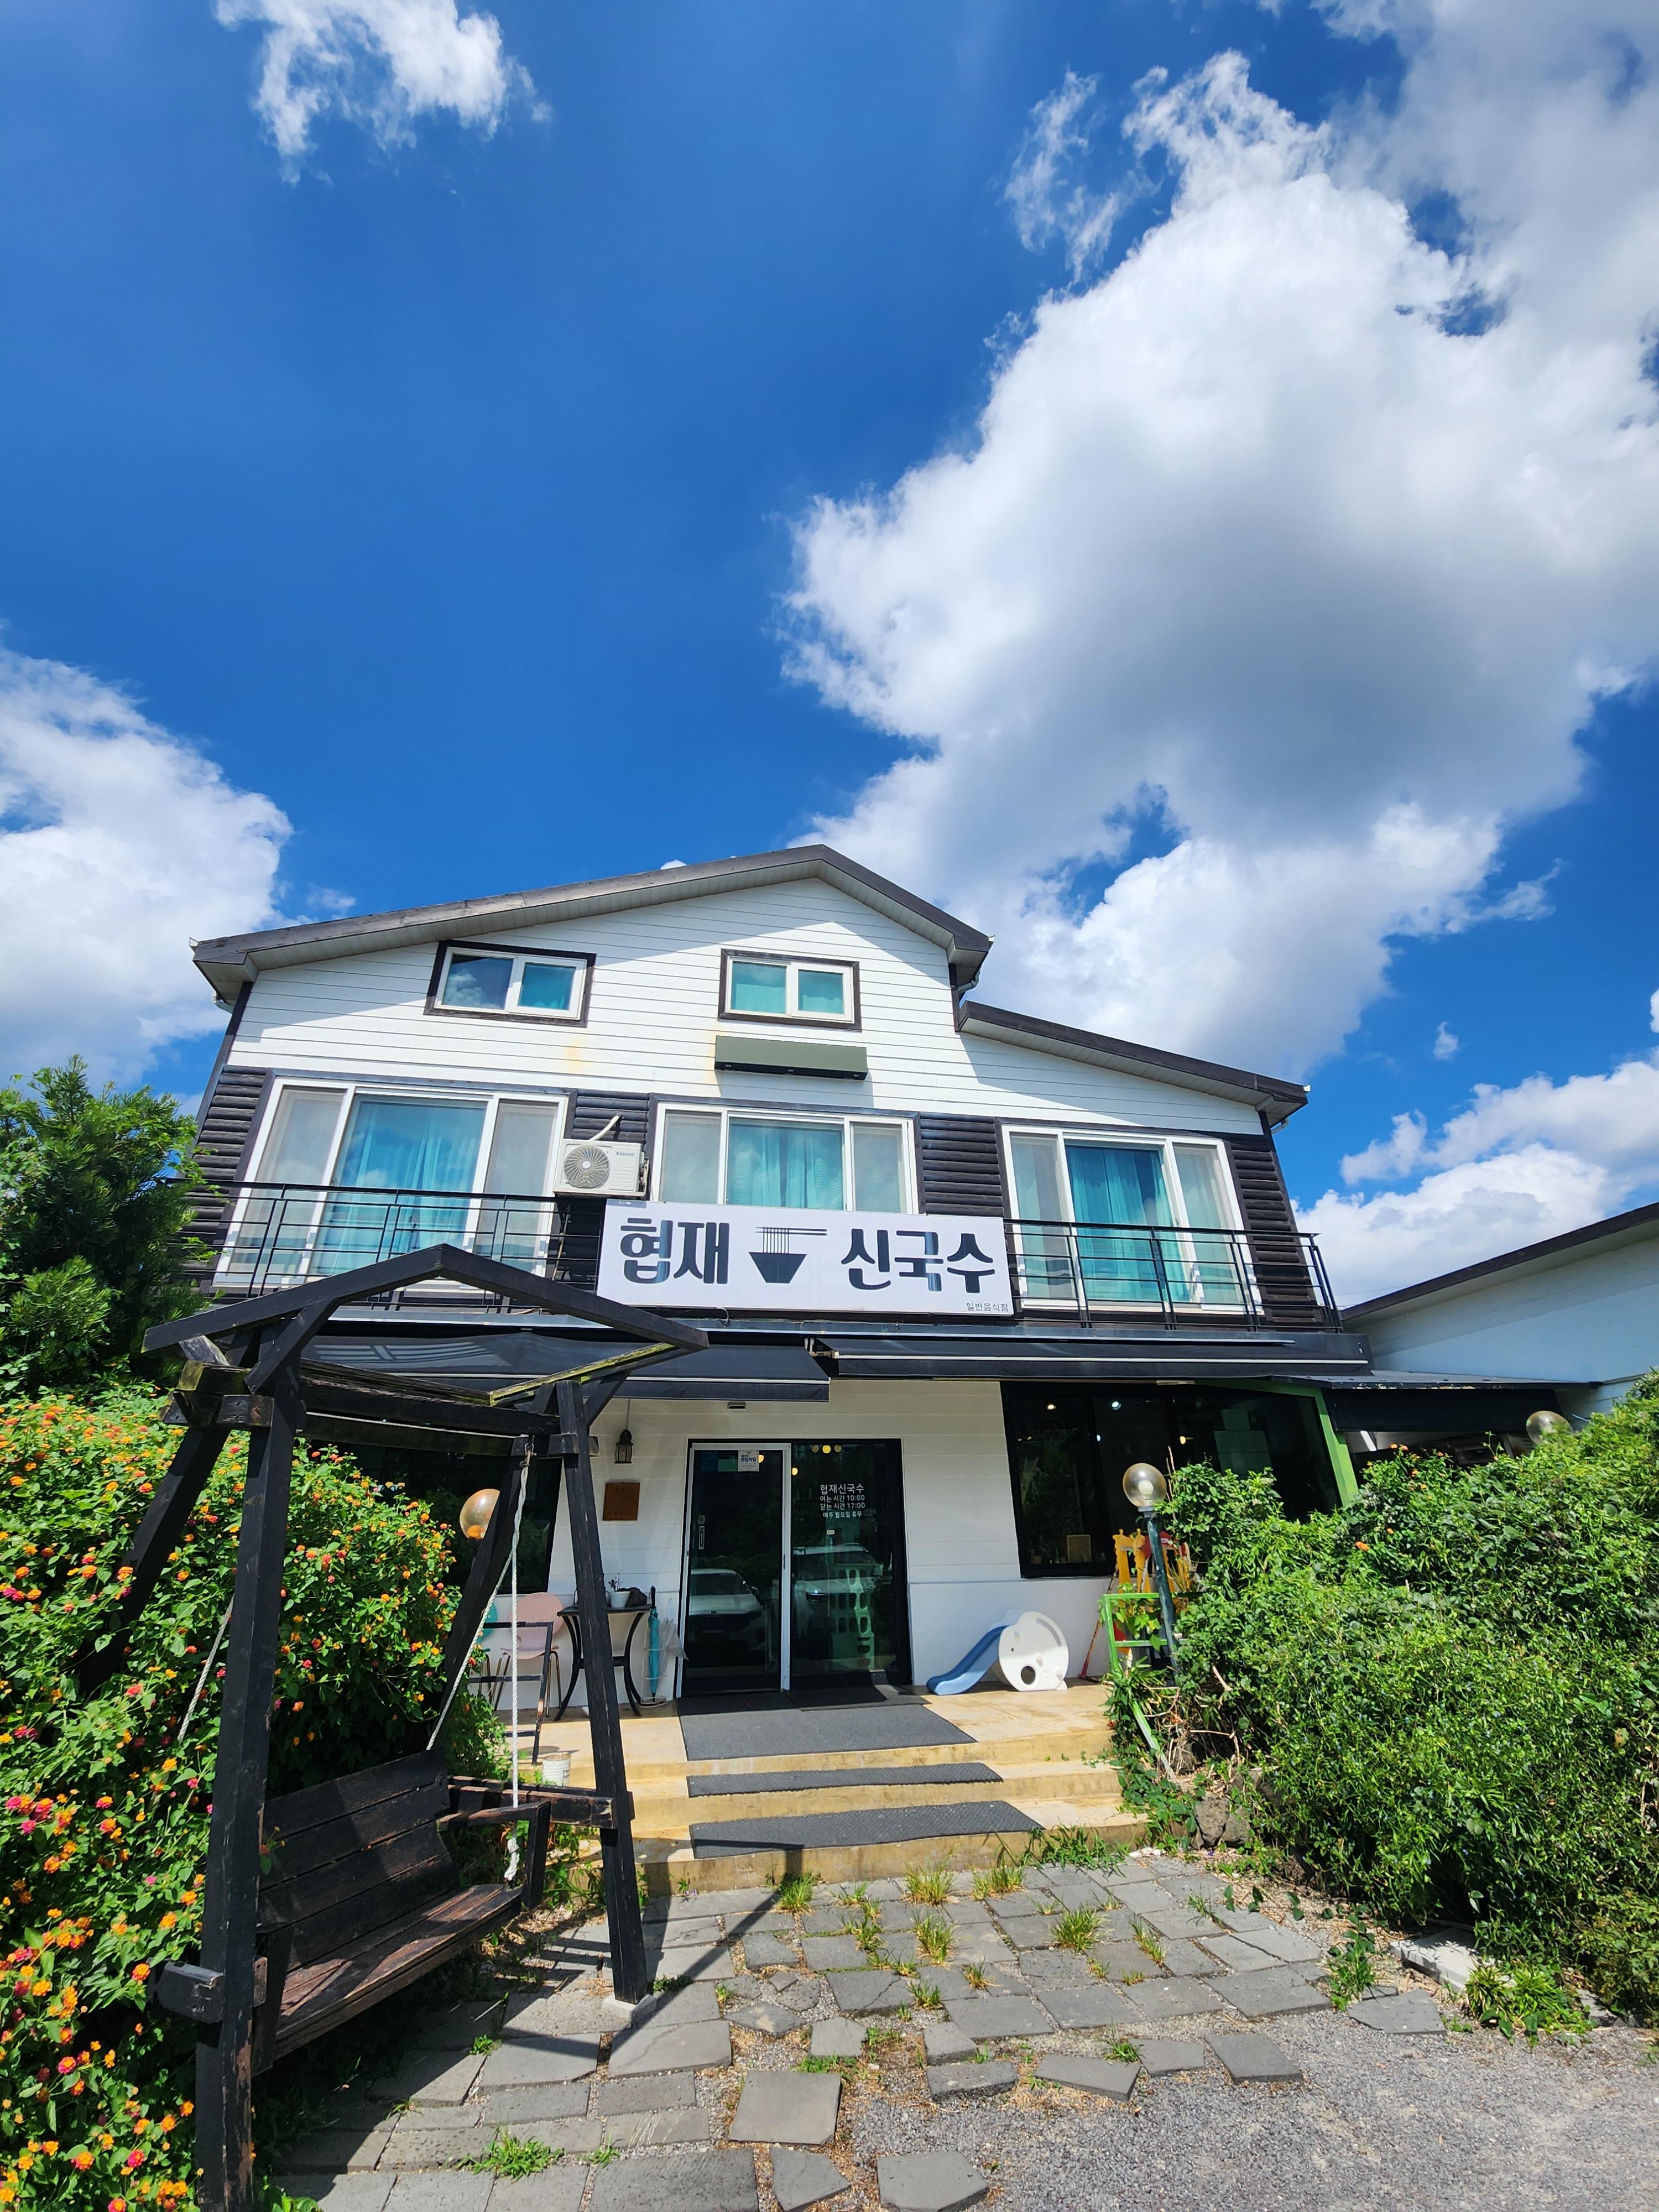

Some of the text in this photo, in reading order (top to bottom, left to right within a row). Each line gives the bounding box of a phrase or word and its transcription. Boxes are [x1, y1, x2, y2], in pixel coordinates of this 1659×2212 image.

[620, 1218, 995, 1293] 협재 신국수
[966, 1302, 1009, 1312] 일반음식점
[820, 1483, 865, 1495] 협재신국수
[820, 1503, 832, 1511] 닫는
